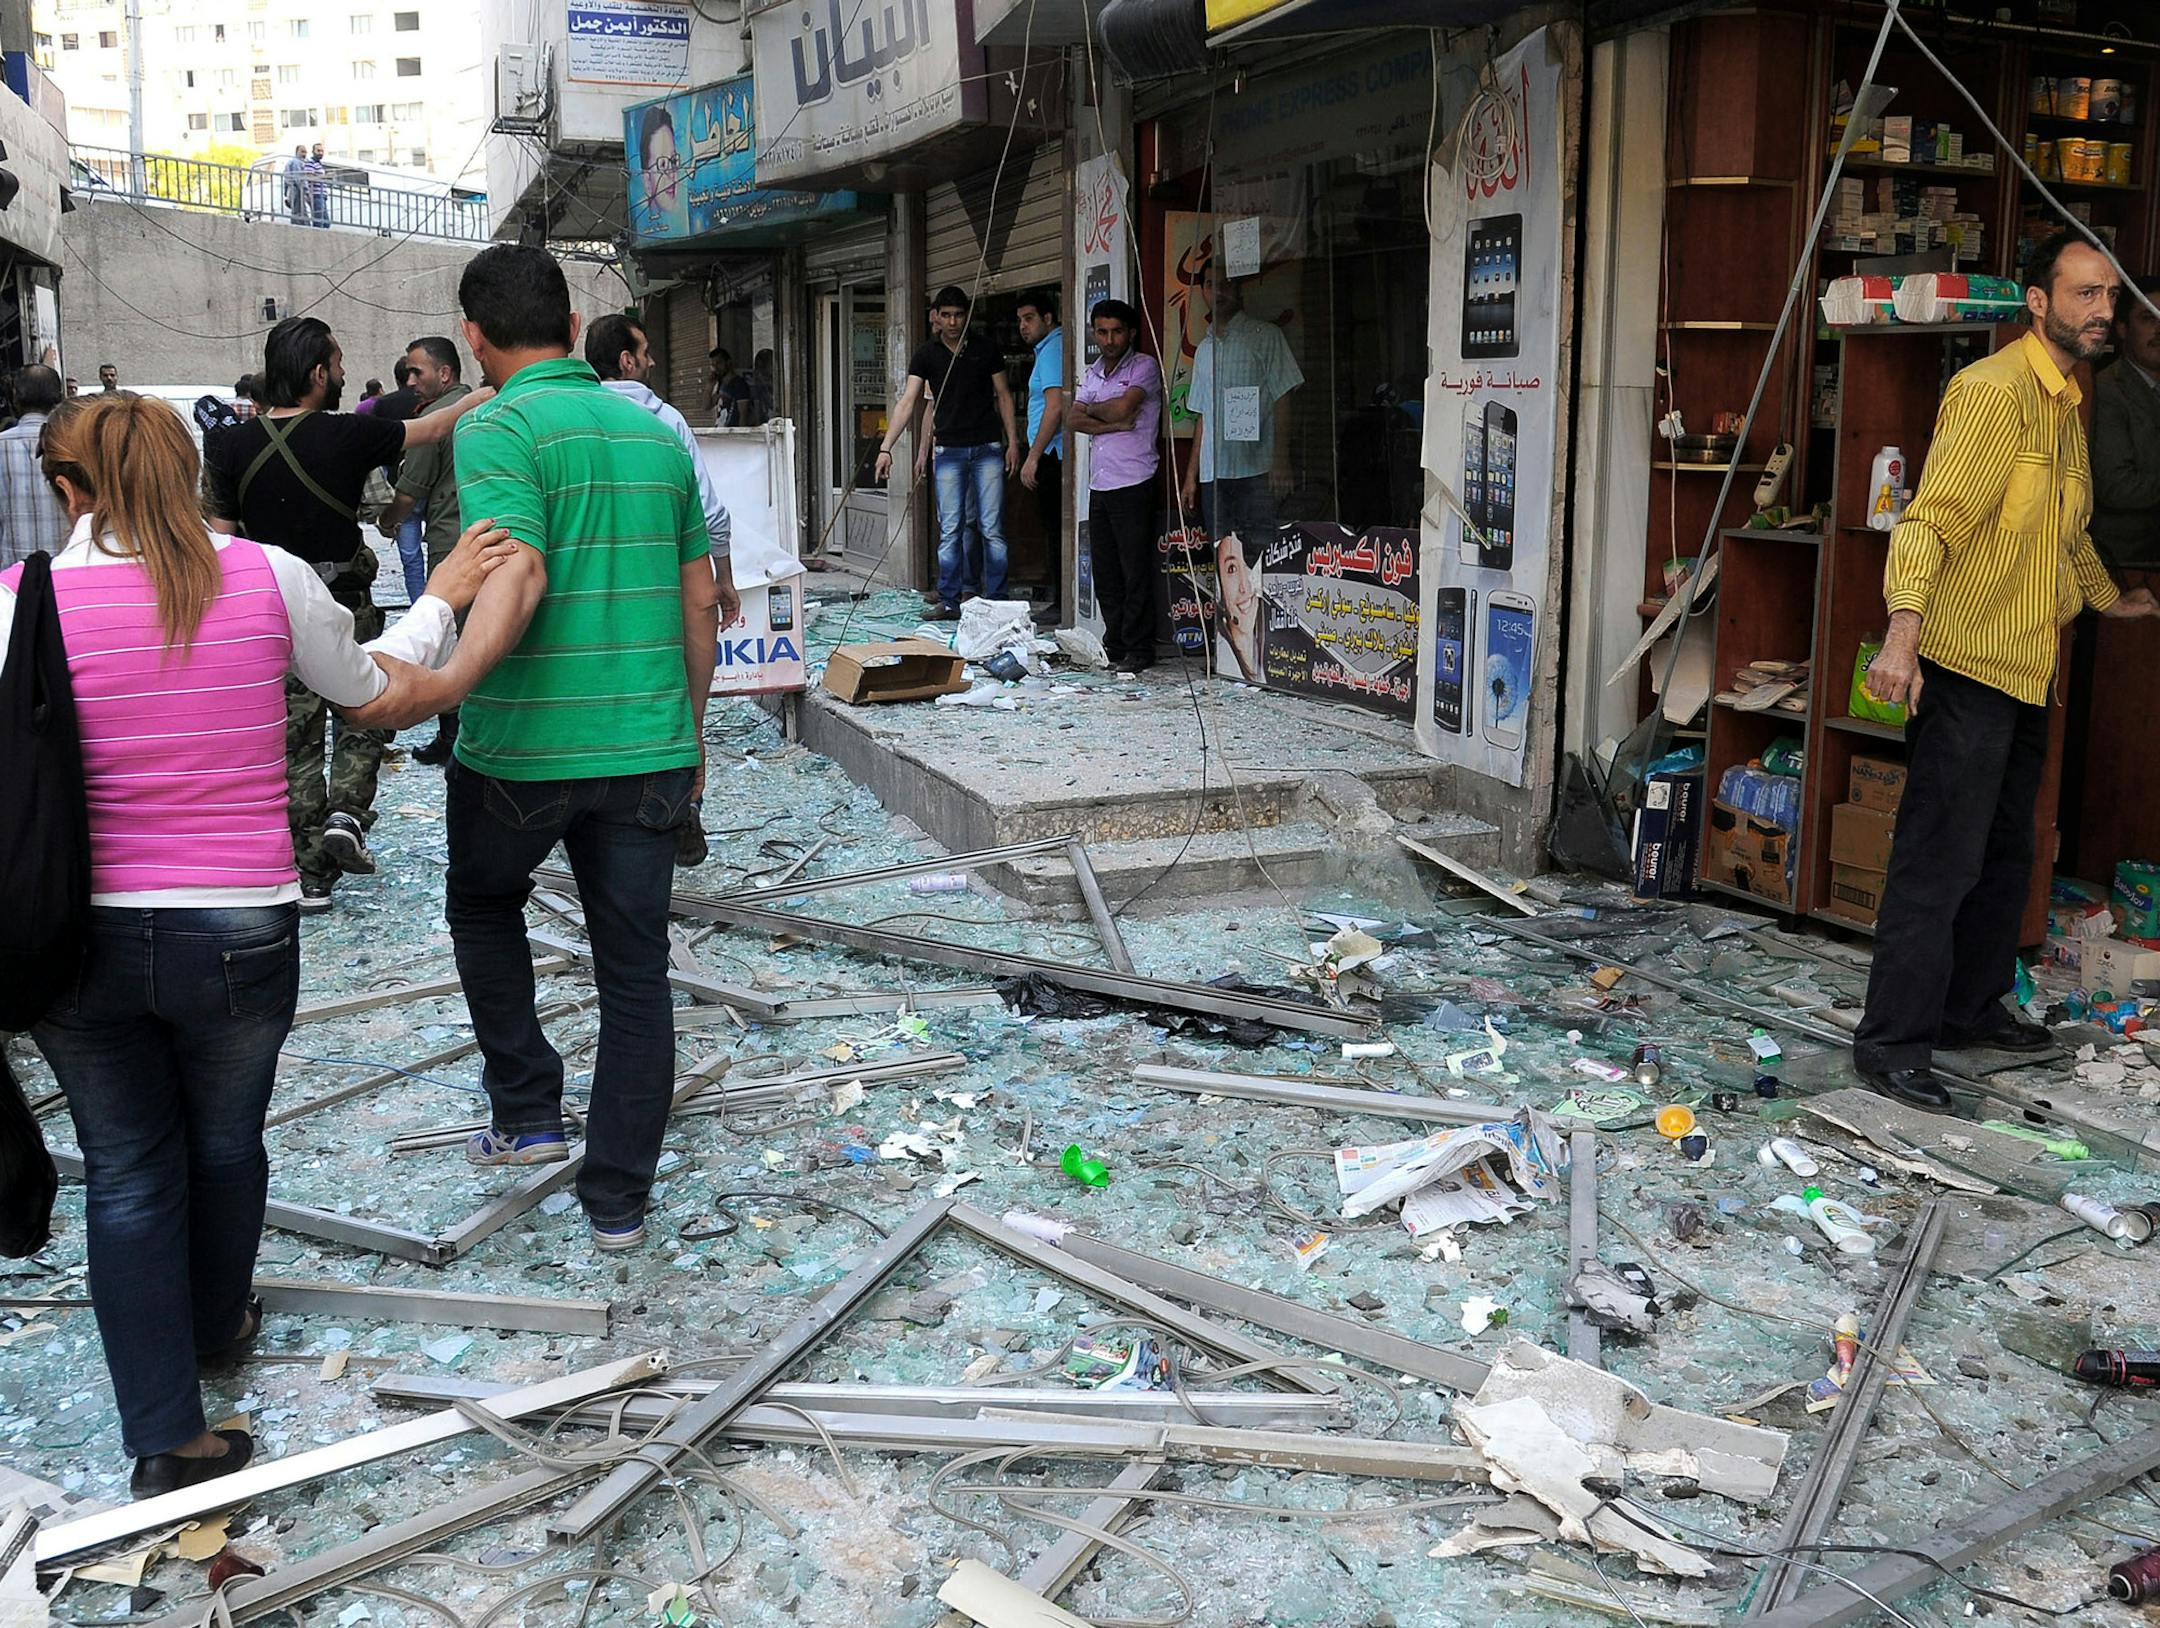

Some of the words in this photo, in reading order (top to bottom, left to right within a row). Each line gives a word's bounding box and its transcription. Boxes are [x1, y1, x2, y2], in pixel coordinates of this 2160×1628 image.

[570, 14, 603, 34] جمل
[604, 15, 638, 34] أيمن
[639, 18, 688, 36] الدكتور
[790, 0, 931, 108] البيان
[1279, 71, 1359, 120] EXPRESS
[1365, 46, 1434, 94] COMPA
[1465, 61, 1531, 201] الله
[1440, 371, 1483, 394] فورية
[1487, 371, 1540, 391] صيانة
[1158, 525, 1211, 553] سبريس
[1306, 534, 1380, 578] اكسبريس
[1381, 537, 1414, 586] فون
[1331, 588, 1353, 620] سوني
[1176, 631, 1203, 643] MTN
[1497, 617, 1524, 637] 12:45
[716, 636, 801, 668] KIA
